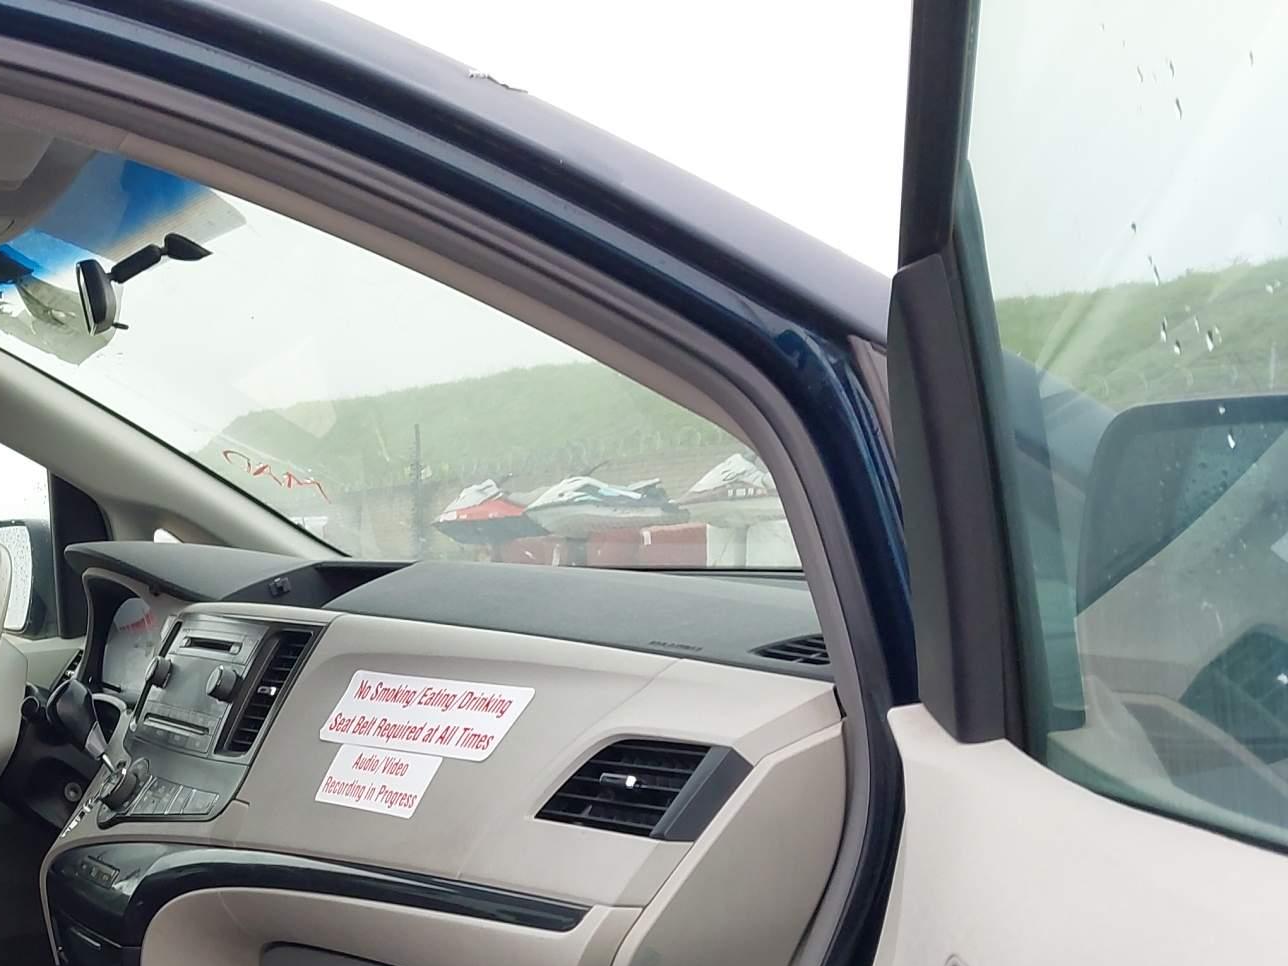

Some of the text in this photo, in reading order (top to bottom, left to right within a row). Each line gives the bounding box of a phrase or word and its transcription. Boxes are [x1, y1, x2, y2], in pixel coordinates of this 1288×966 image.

[354, 680, 372, 700] No
[329, 712, 495, 751] Seat Belt Required at All Times
[352, 752, 410, 777] Audio/Video
[322, 776, 418, 809] Recording in Progress
